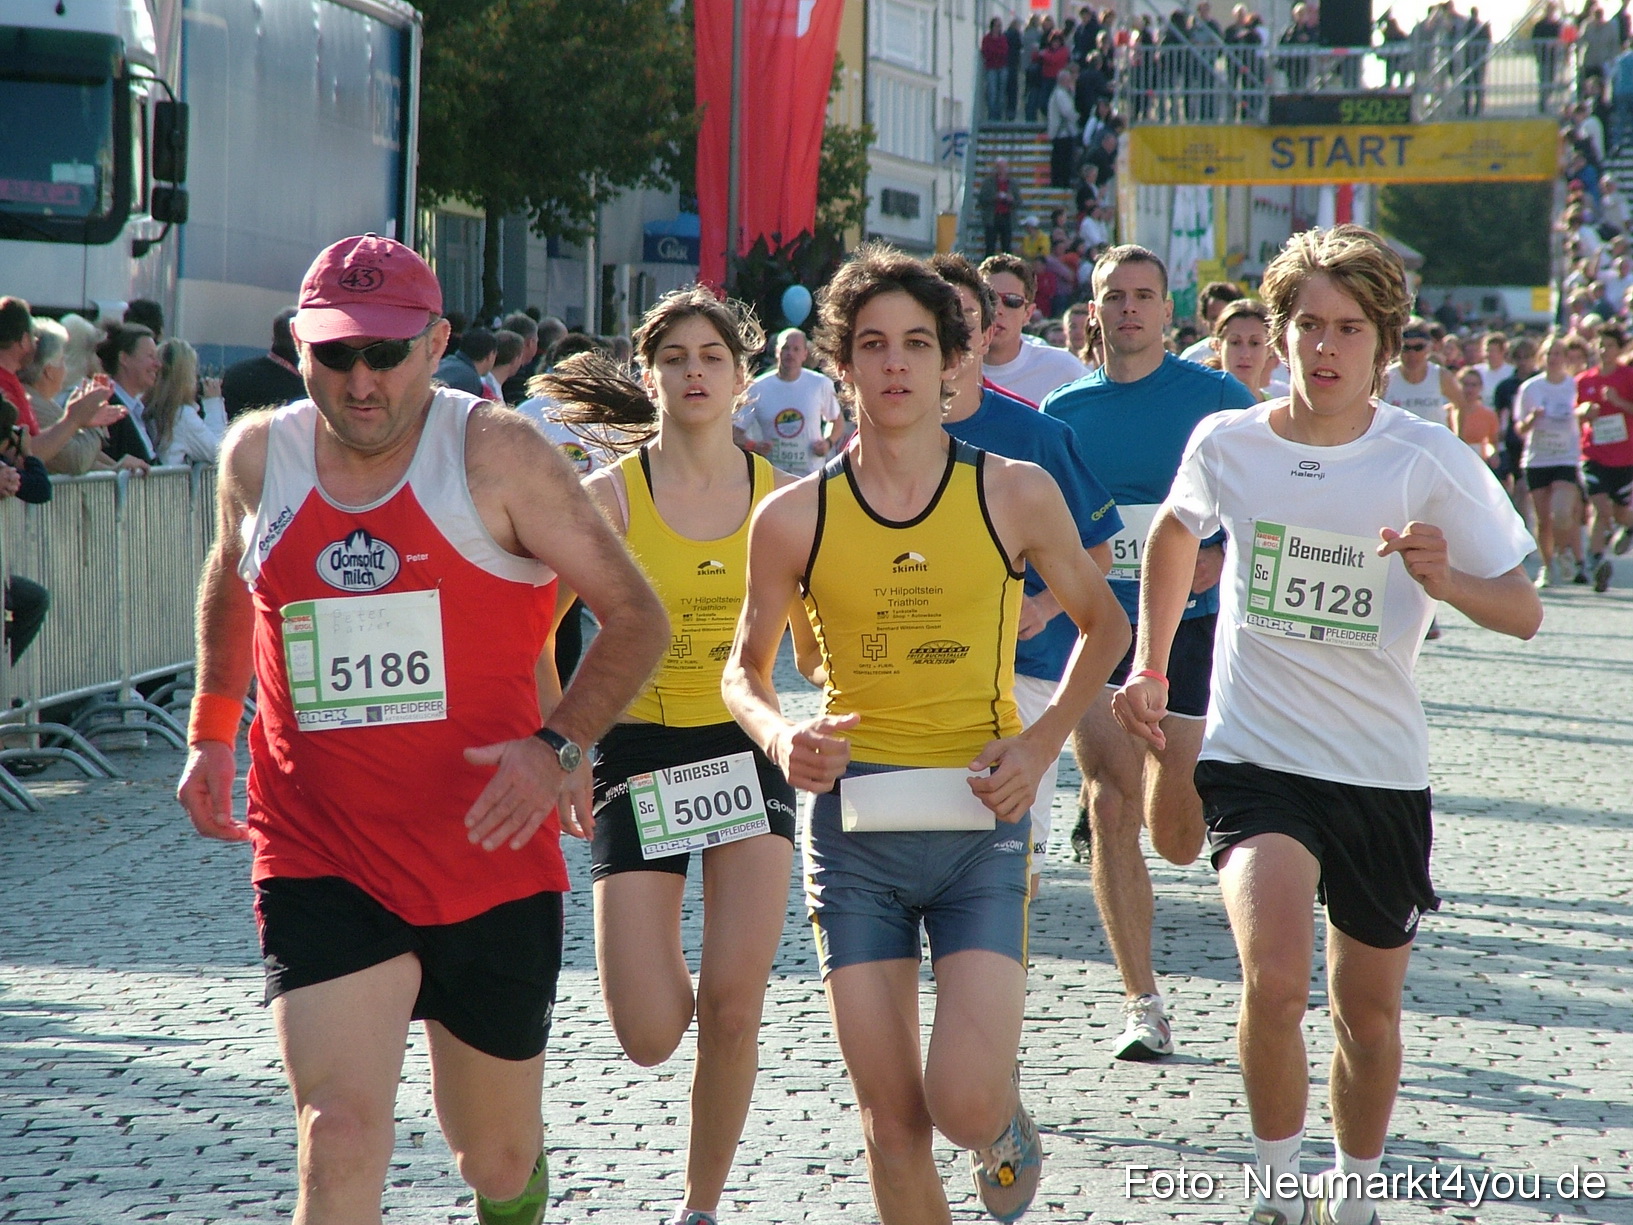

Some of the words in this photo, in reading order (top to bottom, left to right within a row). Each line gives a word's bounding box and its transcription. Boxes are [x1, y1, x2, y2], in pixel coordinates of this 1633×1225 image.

[1271, 135, 1414, 169] START
[341, 269, 374, 287] 43
[1290, 470, 1326, 480] Kalenji
[406, 554, 429, 563] Peter
[1114, 539, 1146, 560] 51
[1288, 536, 1365, 568] Benedikt
[343, 568, 376, 586] milch
[697, 568, 727, 576] skinfit
[892, 563, 928, 574] skinfit
[1254, 563, 1269, 581] Sc
[695, 596, 741, 605] Hilpoltstein
[873, 588, 887, 597] TV
[890, 586, 943, 597] Hilpoltstein
[1285, 577, 1373, 618] 5128
[692, 604, 727, 612] Triathlon
[888, 598, 929, 608] Triathlon
[1247, 614, 1294, 632] BOCK
[1326, 628, 1378, 642] PFLEIDERER
[331, 650, 430, 691] 5186
[299, 708, 348, 724] BOCK
[384, 701, 444, 715] PFLEIDERER
[662, 760, 730, 785] Vanessa
[639, 801, 654, 814] Sc
[674, 785, 752, 825] 5000
[643, 838, 691, 855] BOCK
[720, 820, 767, 837] PFLEIDERER
